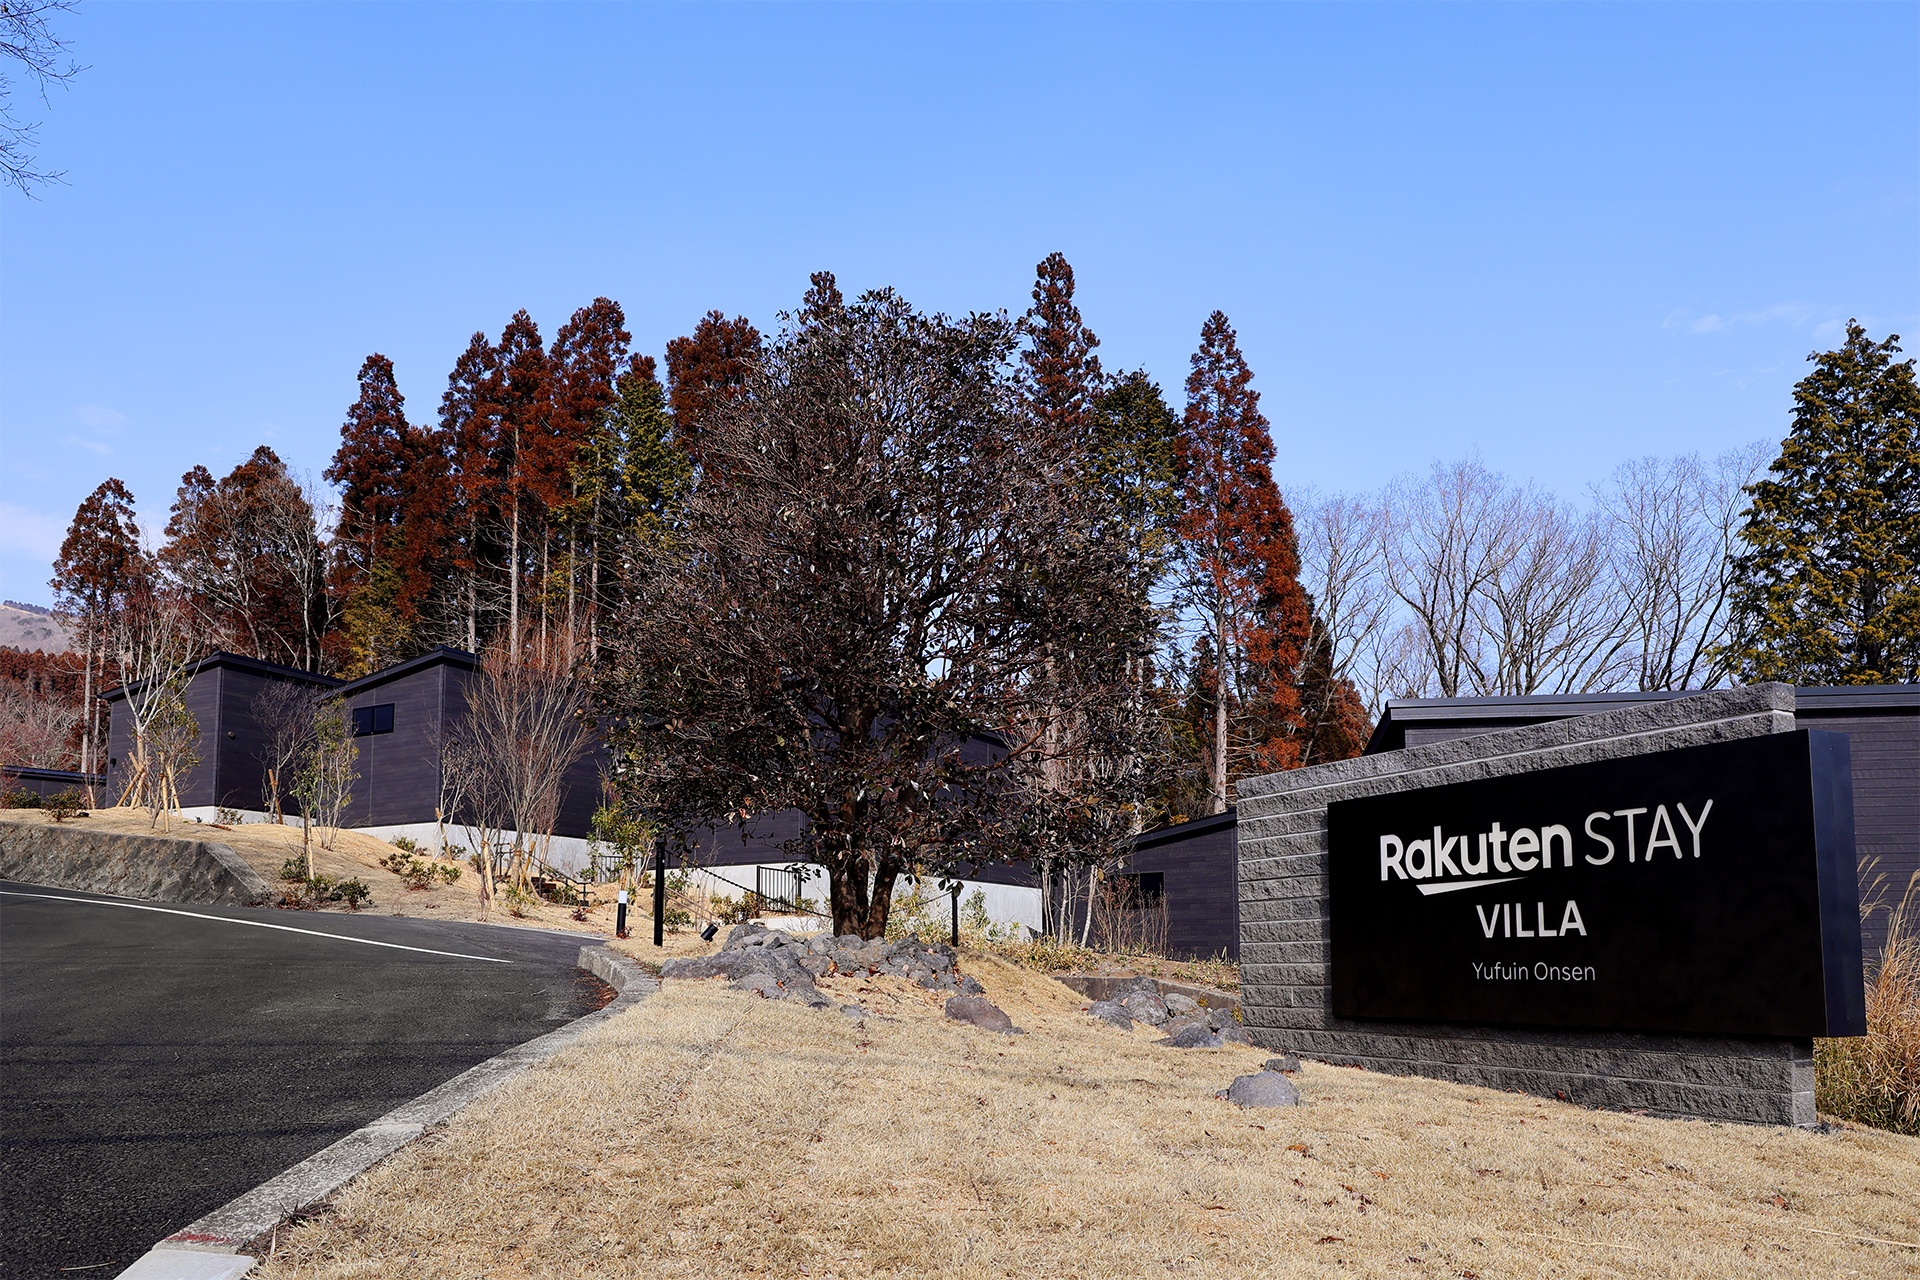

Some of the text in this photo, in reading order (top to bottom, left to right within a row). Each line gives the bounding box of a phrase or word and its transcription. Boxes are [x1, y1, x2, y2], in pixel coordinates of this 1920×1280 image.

[1380, 798, 1714, 882] Rakuten STAY
[1475, 899, 1588, 939] VILLA
[1471, 961, 1596, 982] Yufuin Onsen
